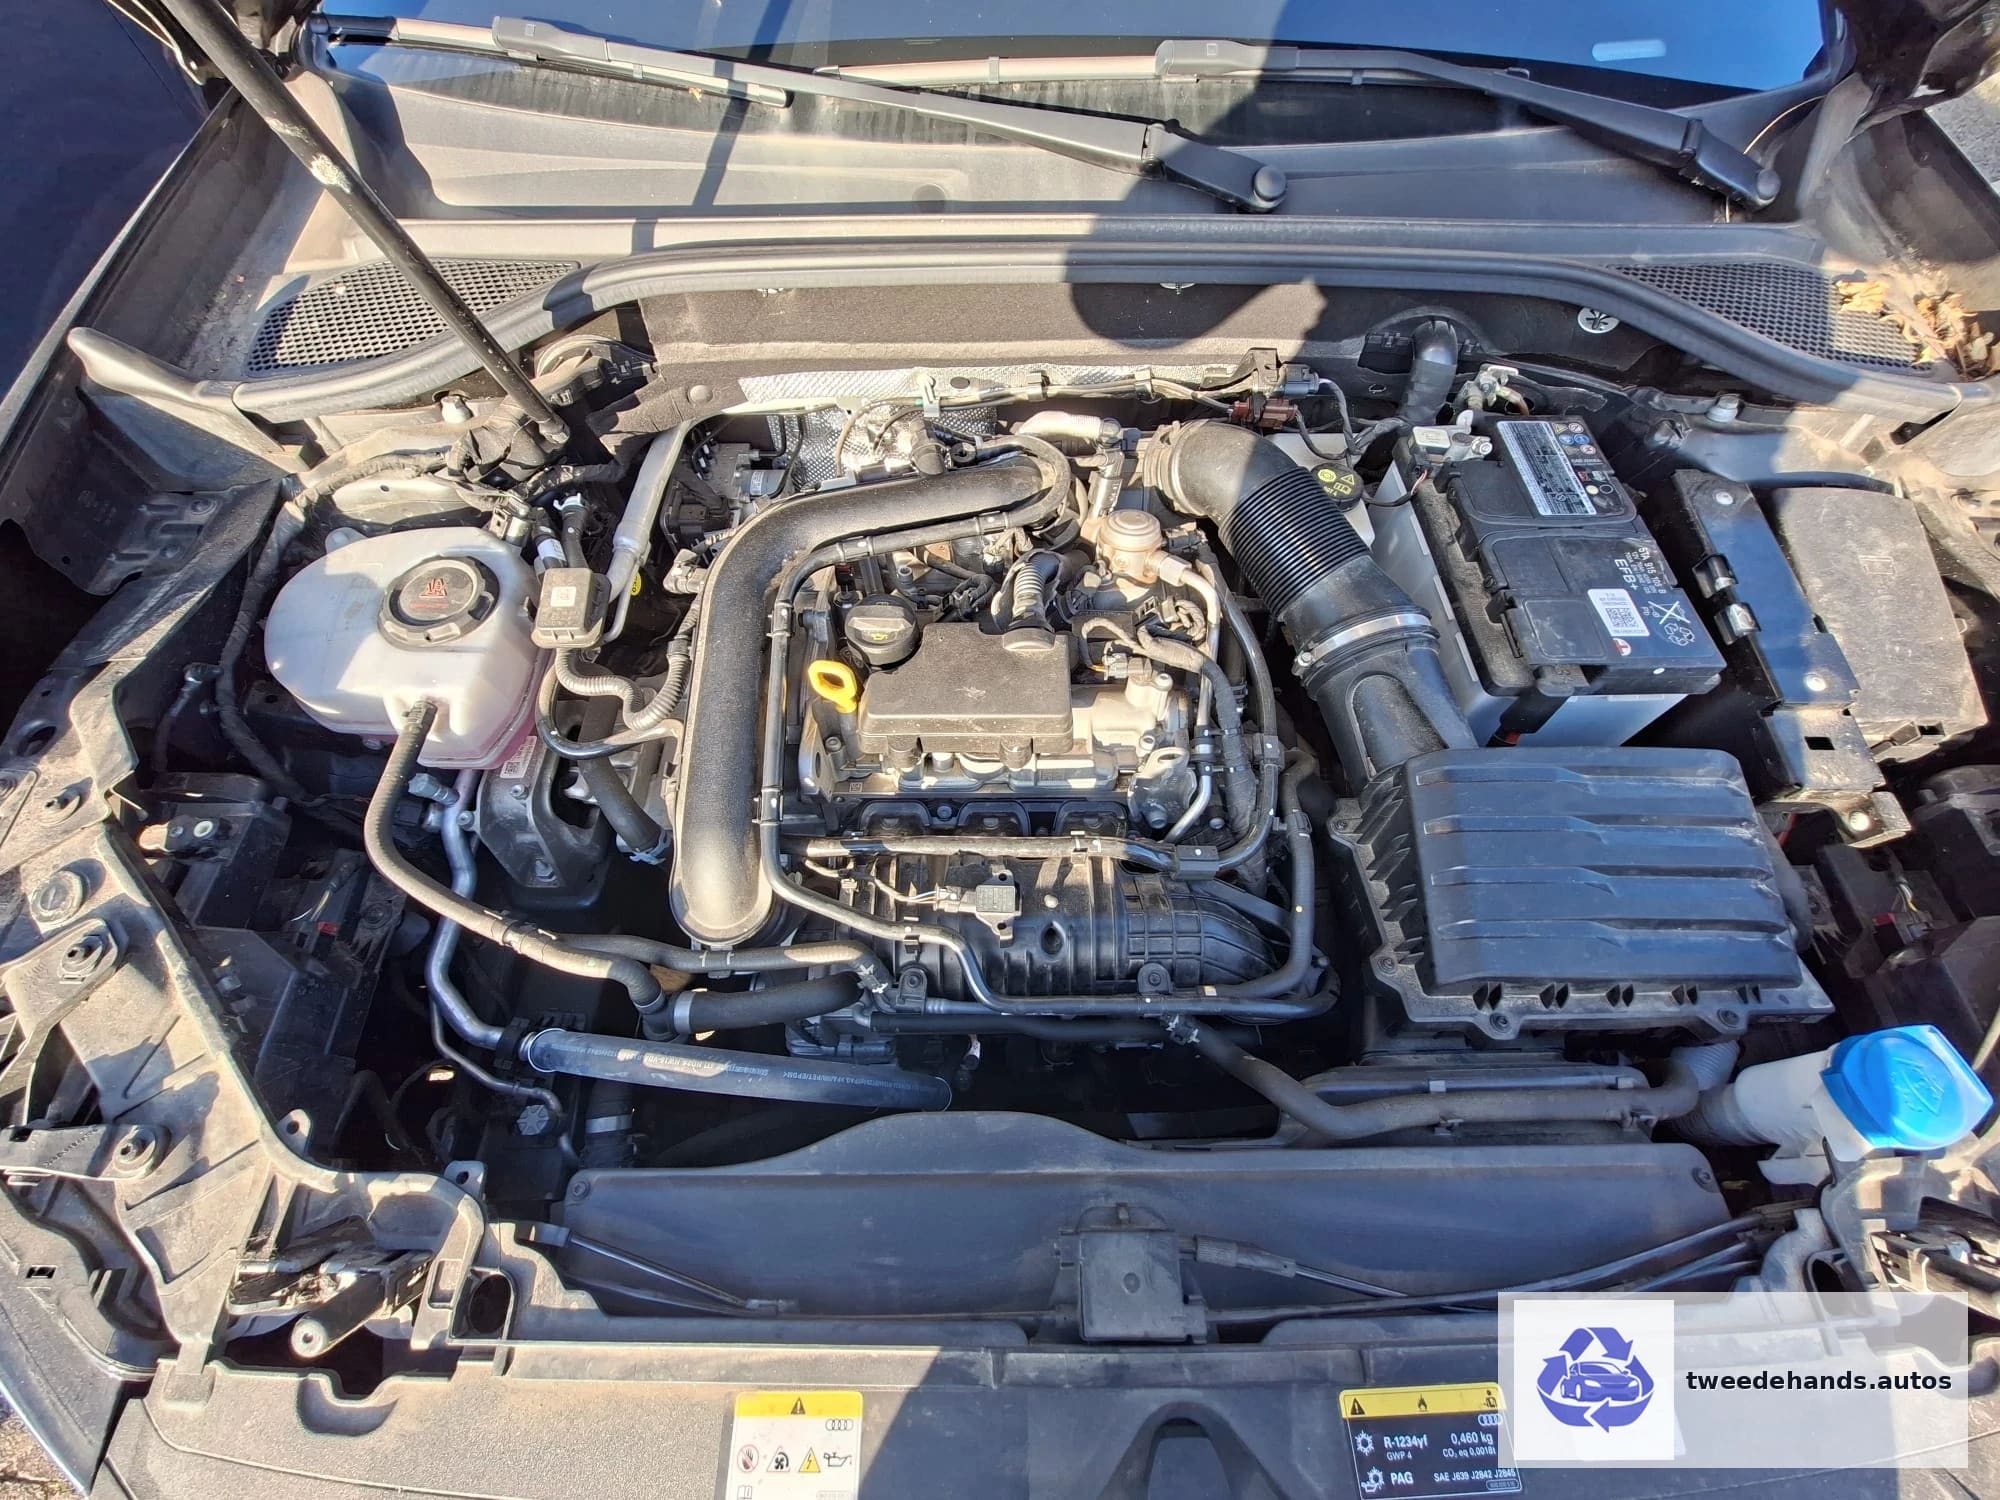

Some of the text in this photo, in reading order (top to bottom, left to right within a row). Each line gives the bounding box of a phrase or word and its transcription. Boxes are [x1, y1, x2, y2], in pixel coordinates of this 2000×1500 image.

[1638, 547, 1650, 560] 5TA
[1644, 563, 1656, 574] 915
[1614, 559, 1639, 590] EFB+
[1383, 1431, 1494, 1449] R-1234yf 0,460 kg
[1386, 1450, 1412, 1461] GWP 4
[1390, 1471, 1414, 1486] PAG
[1433, 1472, 1450, 1482] SAE
[1451, 1471, 1470, 1481] J639
[1471, 1469, 1493, 1480] J2842
